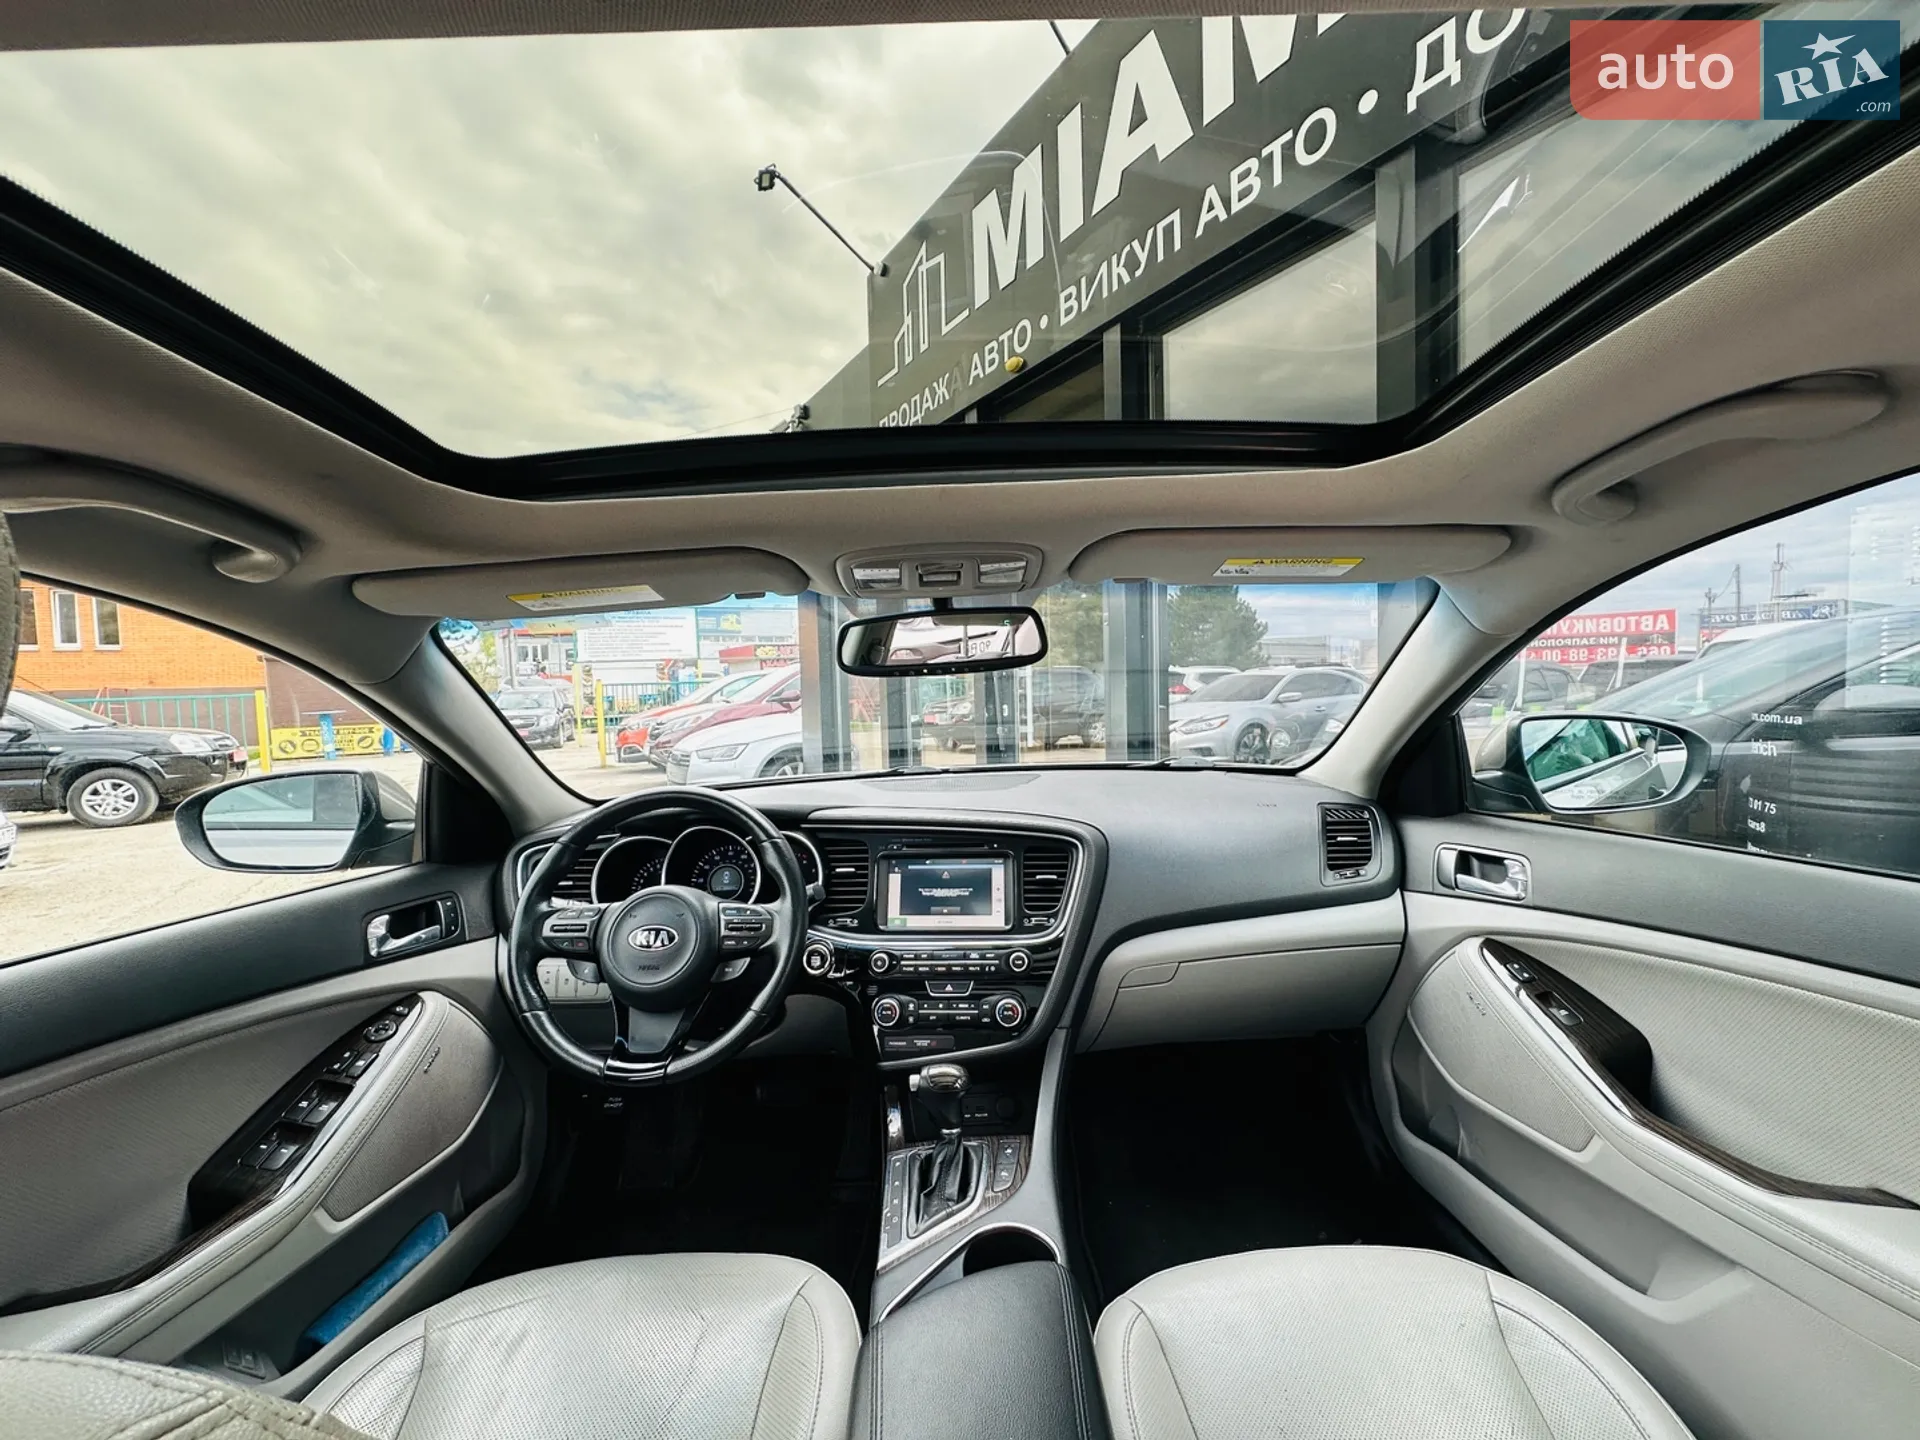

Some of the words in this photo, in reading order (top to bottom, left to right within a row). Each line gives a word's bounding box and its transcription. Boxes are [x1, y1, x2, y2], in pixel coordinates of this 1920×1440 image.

[968, 318, 1032, 385] АВТО
[1059, 208, 1182, 326] ВИКУП
[1194, 105, 1338, 239] АВТО
[635, 930, 670, 948] KIA
